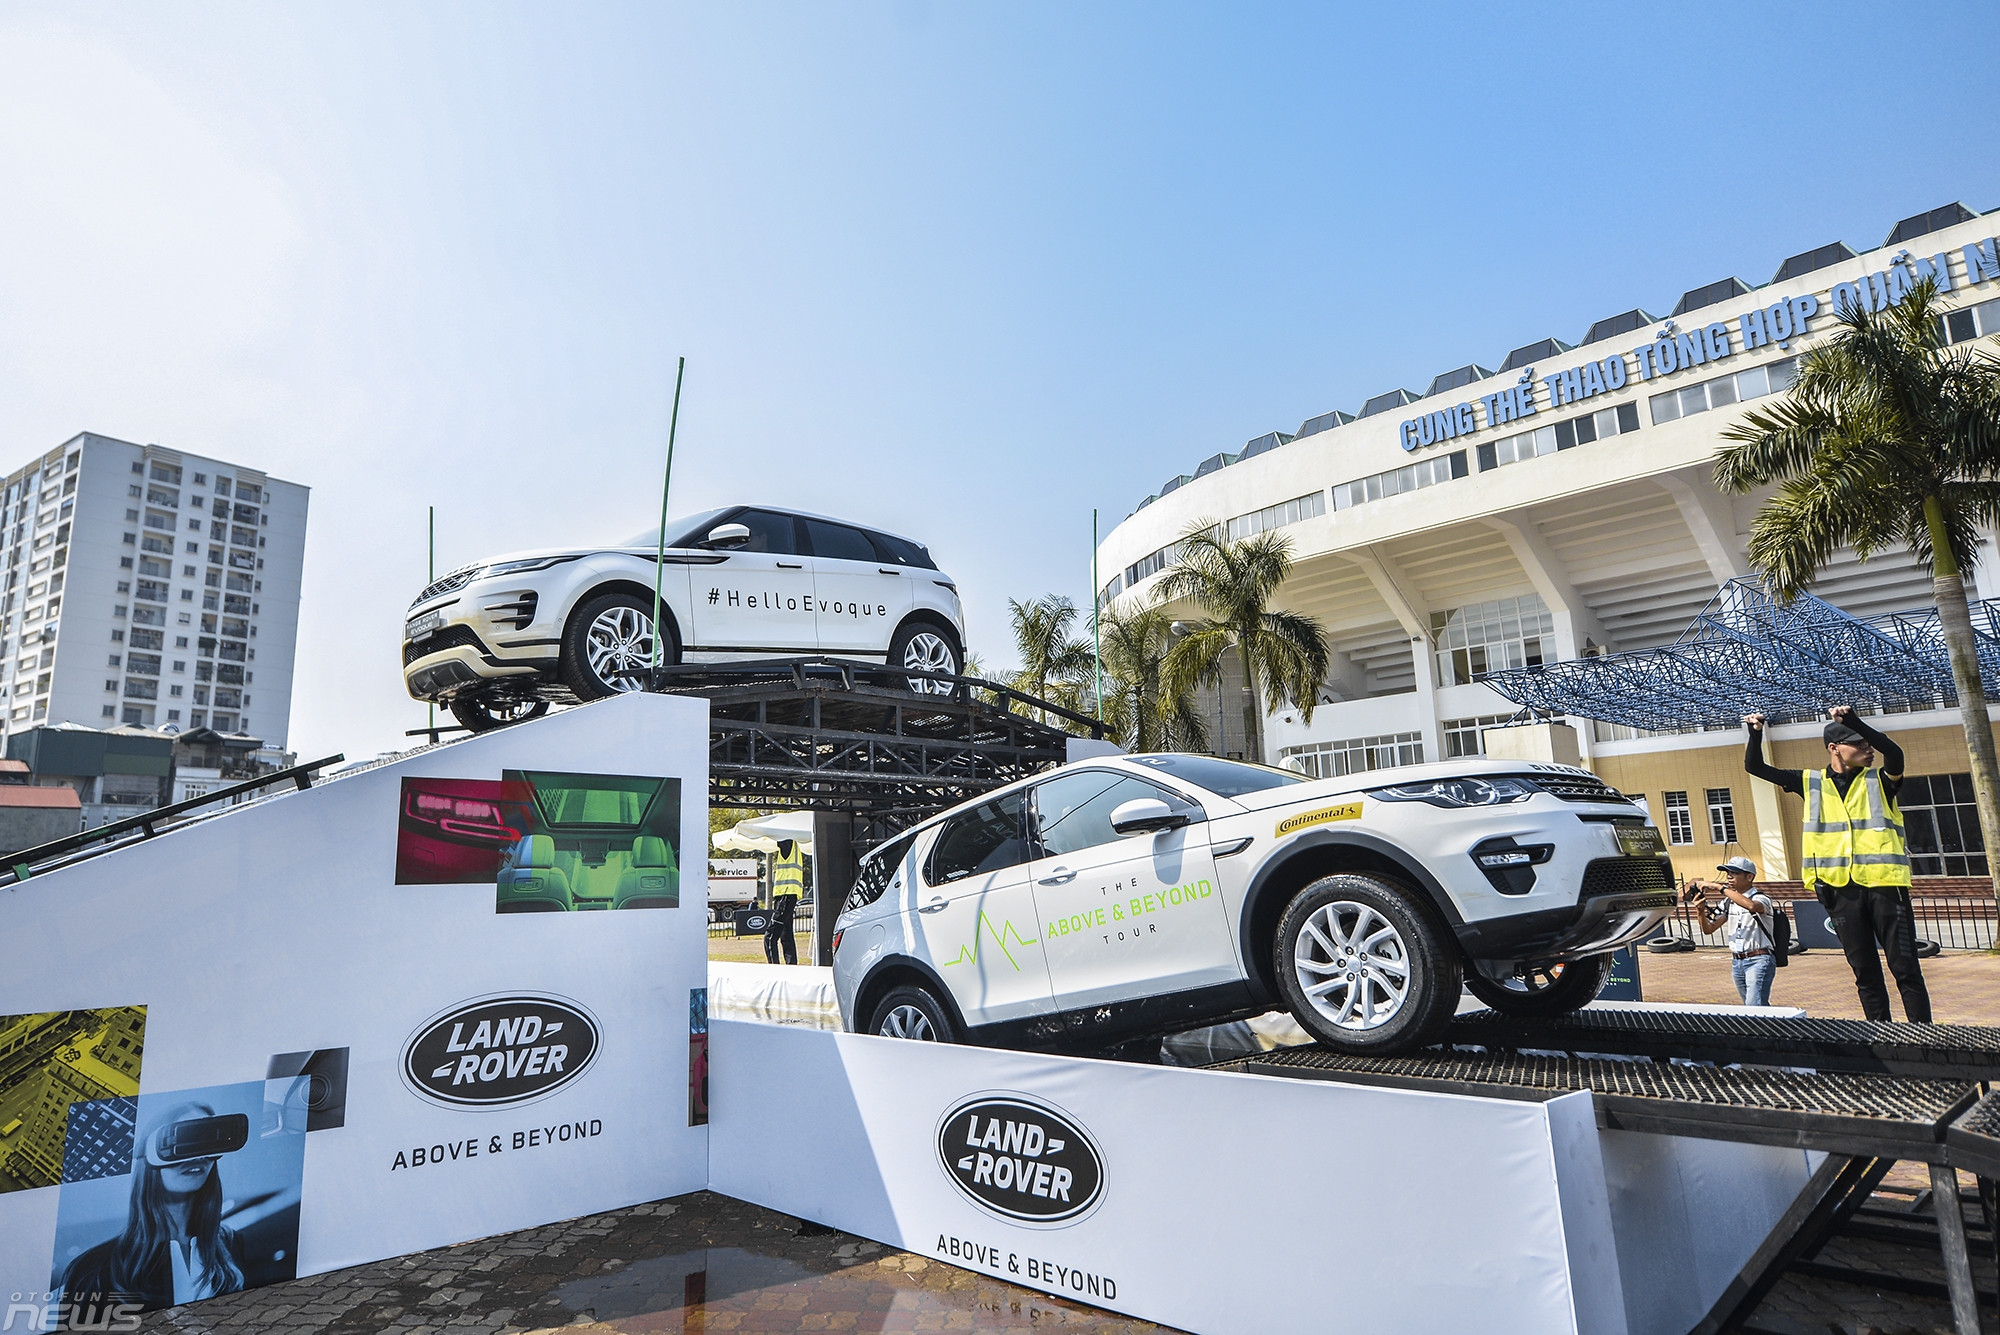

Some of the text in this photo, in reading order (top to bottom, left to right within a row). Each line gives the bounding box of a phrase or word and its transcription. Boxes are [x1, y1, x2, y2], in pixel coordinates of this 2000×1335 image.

[1399, 401, 1475, 451] CUNG
[1480, 366, 1537, 427] THỂ
[1543, 354, 1627, 407] THAO
[1633, 320, 1731, 381] TỔNG
[1738, 294, 1818, 350] HỢP
[708, 587, 887, 618] #HelloEvoque
[1279, 807, 1345, 832] Continental
[1617, 829, 1659, 839] DISCOVERY
[1629, 841, 1655, 850] SPORT
[1101, 877, 1138, 896] THE
[1048, 878, 1213, 939] ABOVE & BEYOND
[1103, 923, 1157, 945] TOUR
[446, 1015, 542, 1053] LAND
[452, 1044, 569, 1086] ROVER
[391, 1119, 602, 1171] ABOVE & BEYOND
[966, 1114, 1045, 1158] LAND
[973, 1151, 1073, 1202] ROVER
[936, 1233, 1117, 1301] ABOVE & BEYOND
